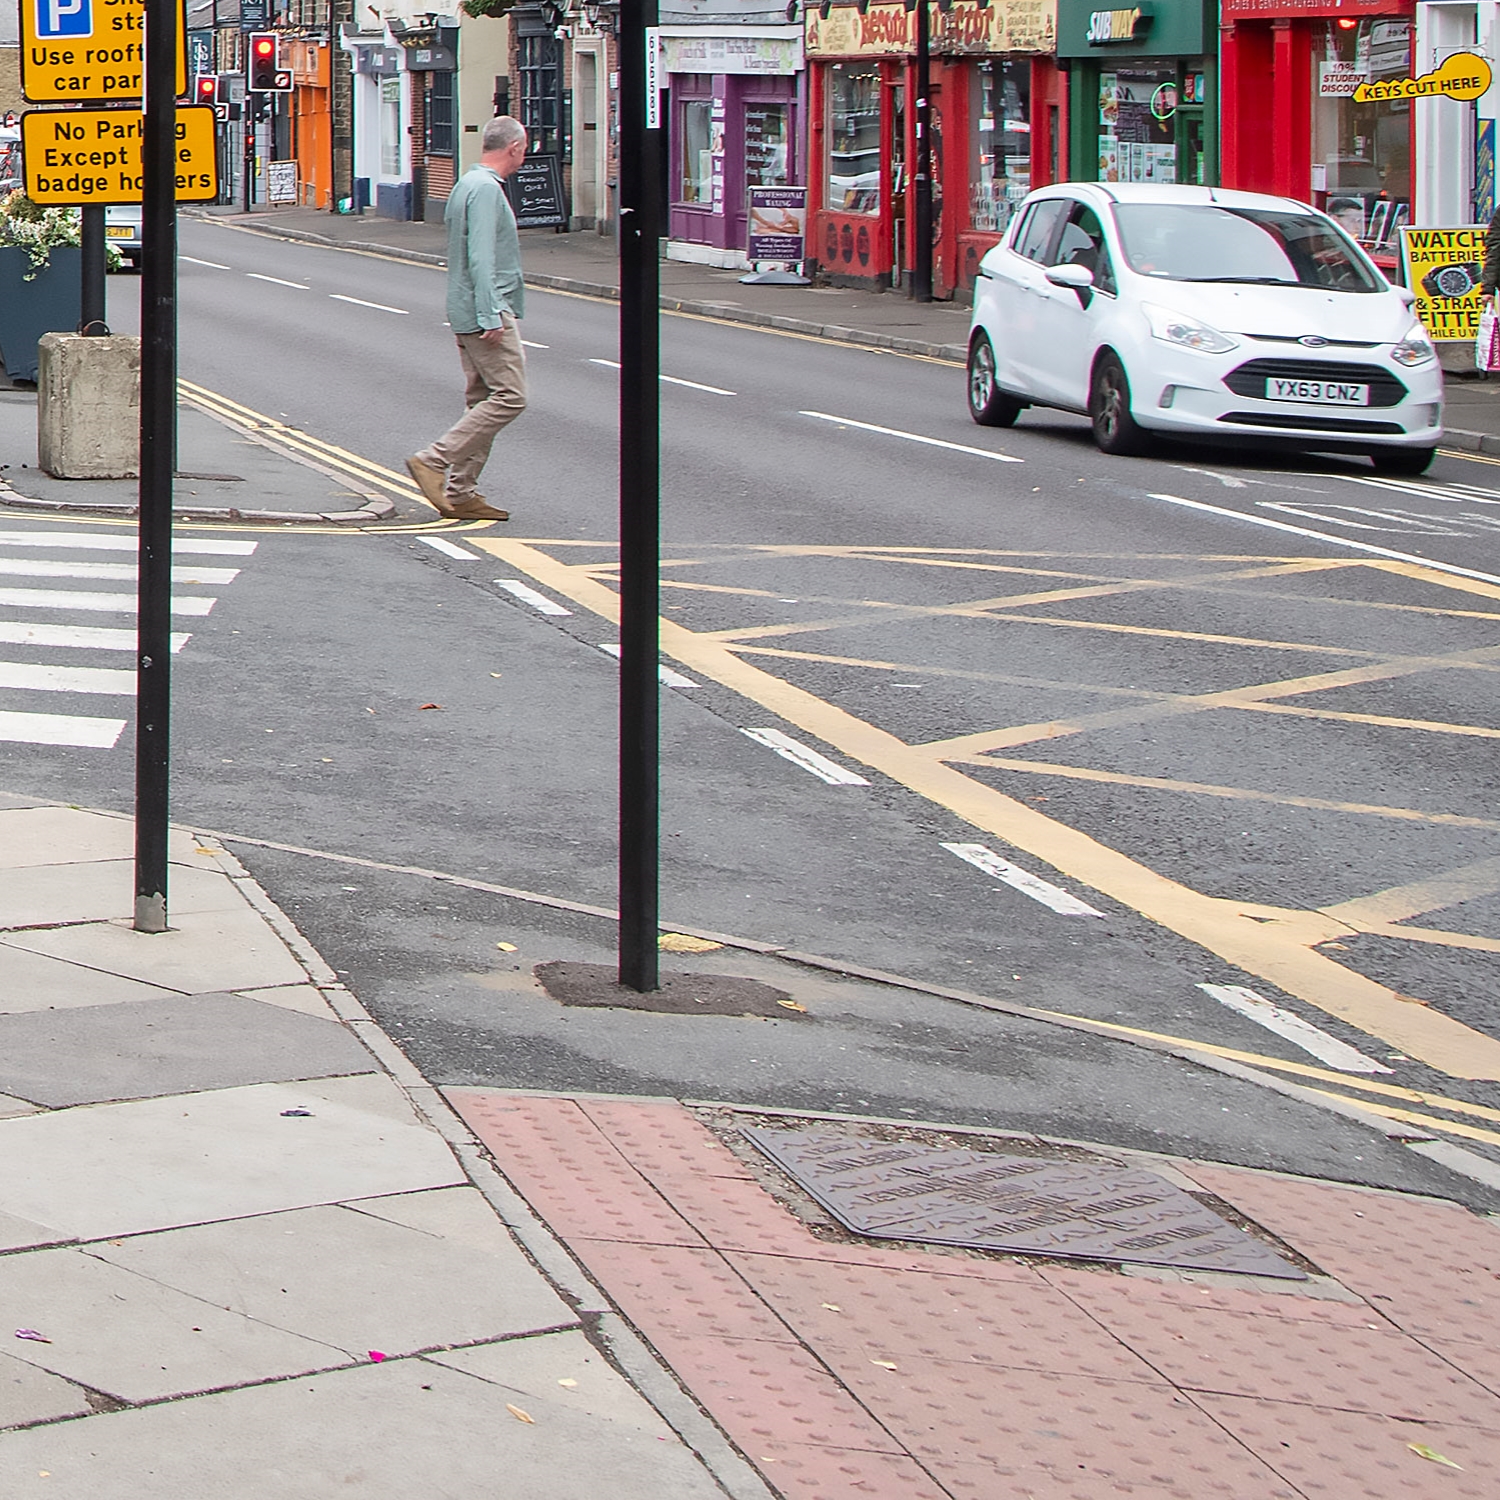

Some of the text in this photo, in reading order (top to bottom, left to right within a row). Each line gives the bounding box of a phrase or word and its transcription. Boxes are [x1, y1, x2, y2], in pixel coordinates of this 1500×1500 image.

[111, 11, 144, 31] sta
[1086, 6, 1142, 42] SUBWAY
[31, 43, 144, 67] Use rooft
[1332, 63, 1356, 73] 10%
[53, 74, 142, 93] car par
[1322, 74, 1368, 83] STUDENT
[1320, 84, 1356, 93] DISCOU
[1363, 76, 1482, 100] KEYS CUT HERE
[54, 119, 187, 142] No Parg
[44, 146, 128, 169] Except
[36, 171, 211, 195] badge hoers
[753, 191, 804, 200] PROFESSIONAL
[764, 199, 793, 208] WAXING
[1408, 231, 1487, 248] WATCH
[1410, 250, 1488, 263] BATTERIES
[1415, 297, 1428, 310] &
[1418, 311, 1480, 328] FITTE
[1427, 328, 1456, 338] HILE
[1458, 328, 1467, 338] U
[1275, 380, 1361, 401] YX63 CNZ
